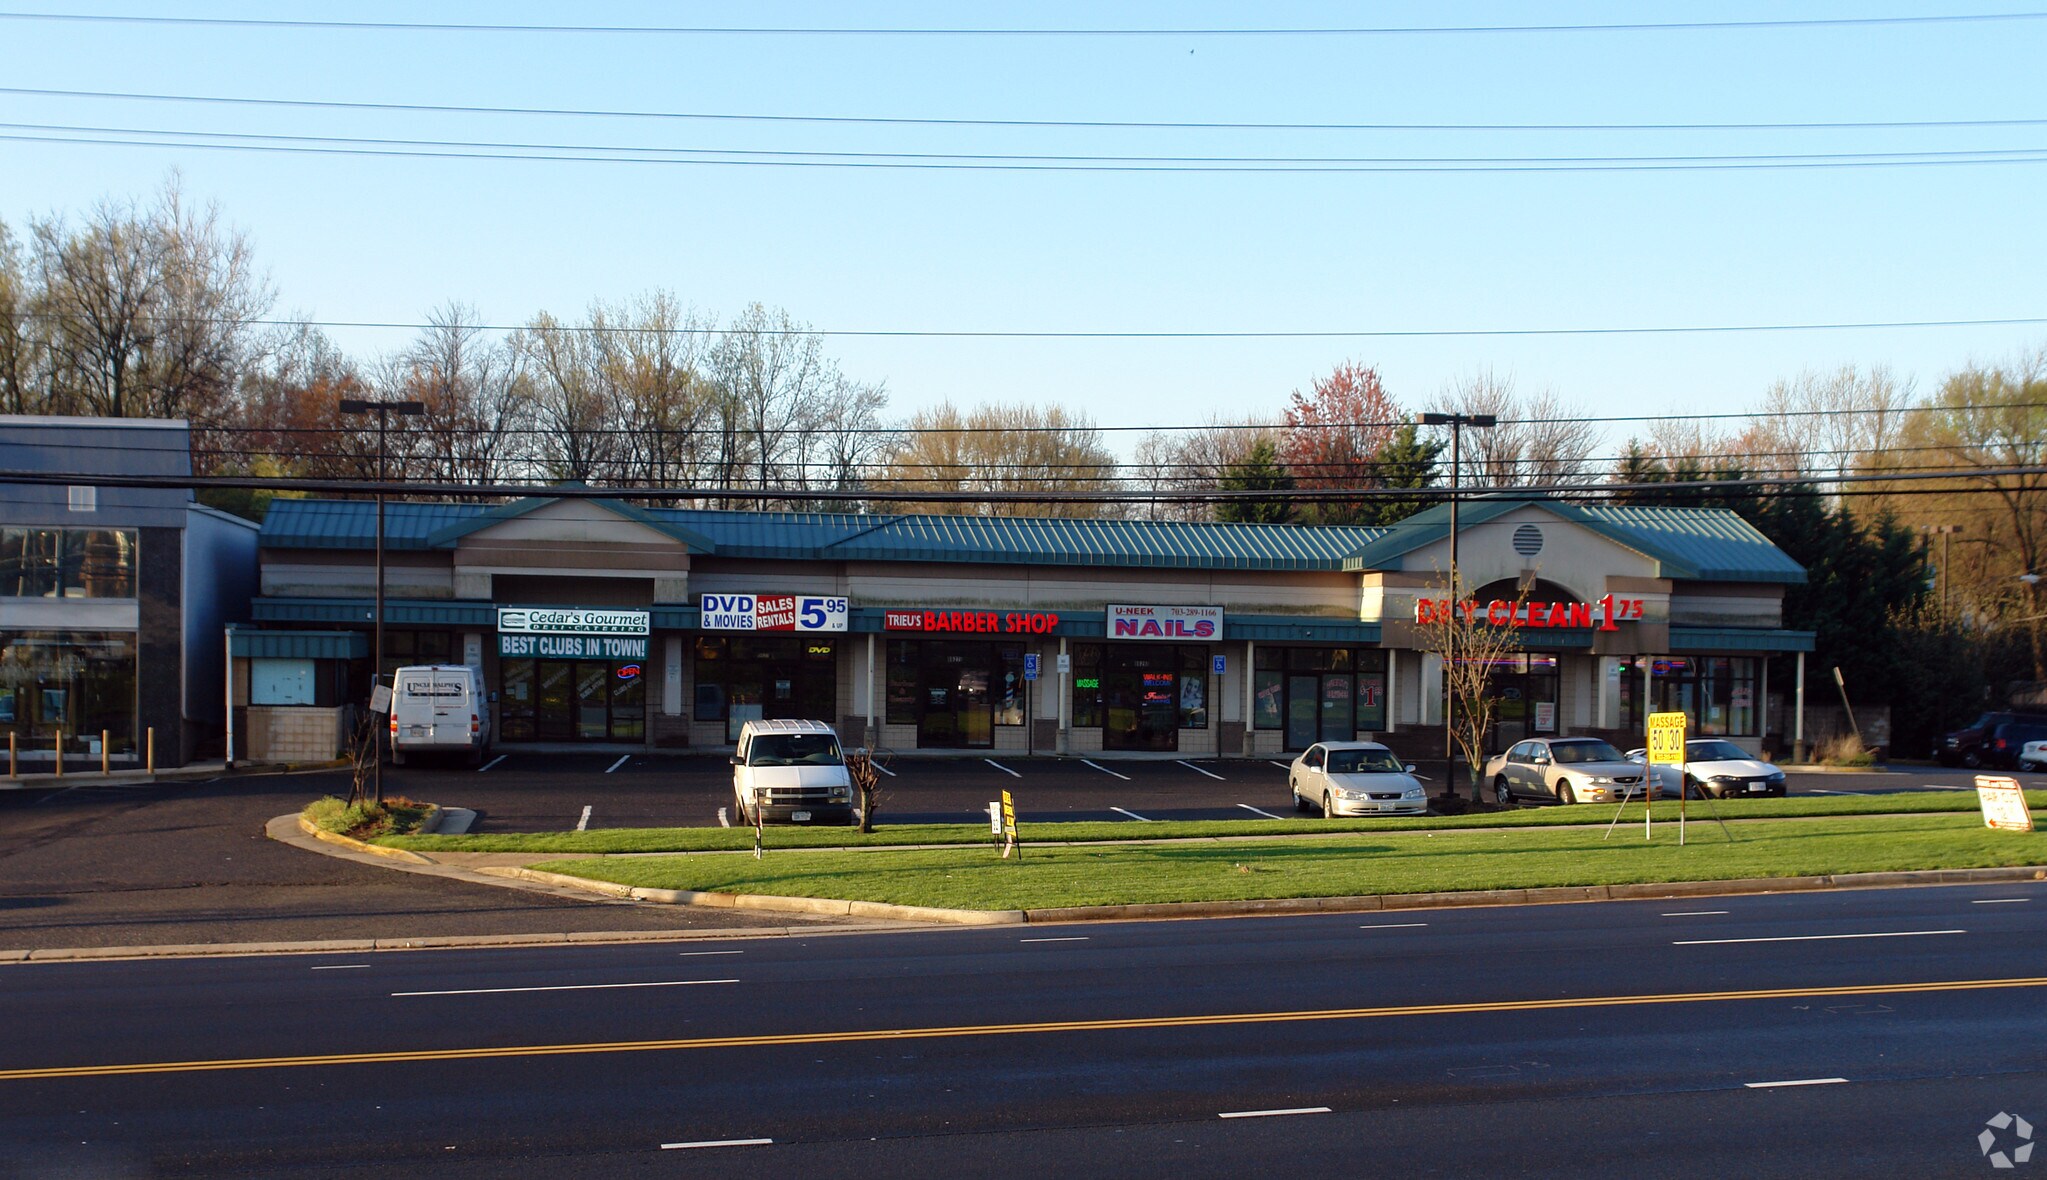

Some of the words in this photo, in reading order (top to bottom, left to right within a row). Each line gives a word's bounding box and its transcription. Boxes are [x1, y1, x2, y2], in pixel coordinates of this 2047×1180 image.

[703, 596, 753, 612] DVD
[757, 597, 794, 614] SALES
[1115, 607, 1154, 615] U-NEEK
[1171, 608, 1217, 616] 703-289-1166
[529, 611, 580, 624] Cedar's
[584, 612, 647, 625] Gourmet
[703, 614, 711, 628] &
[714, 614, 753, 628] MOVIES
[756, 611, 795, 629] RENTALS
[1488, 600, 1592, 628] CLEAN
[888, 614, 921, 627] TRIEU'S
[923, 611, 999, 633] BARBER
[1006, 612, 1059, 634] SHOP
[1115, 619, 1216, 637] NAILS
[502, 635, 536, 654] BEST
[539, 636, 583, 656] CLUBS
[586, 638, 600, 656] IN
[603, 638, 646, 657] TOWN!
[808, 646, 831, 654] DVD
[616, 667, 641, 677] OPEN
[1076, 679, 1099, 689] MASSAGE
[1650, 716, 1685, 728] MASSAGE
